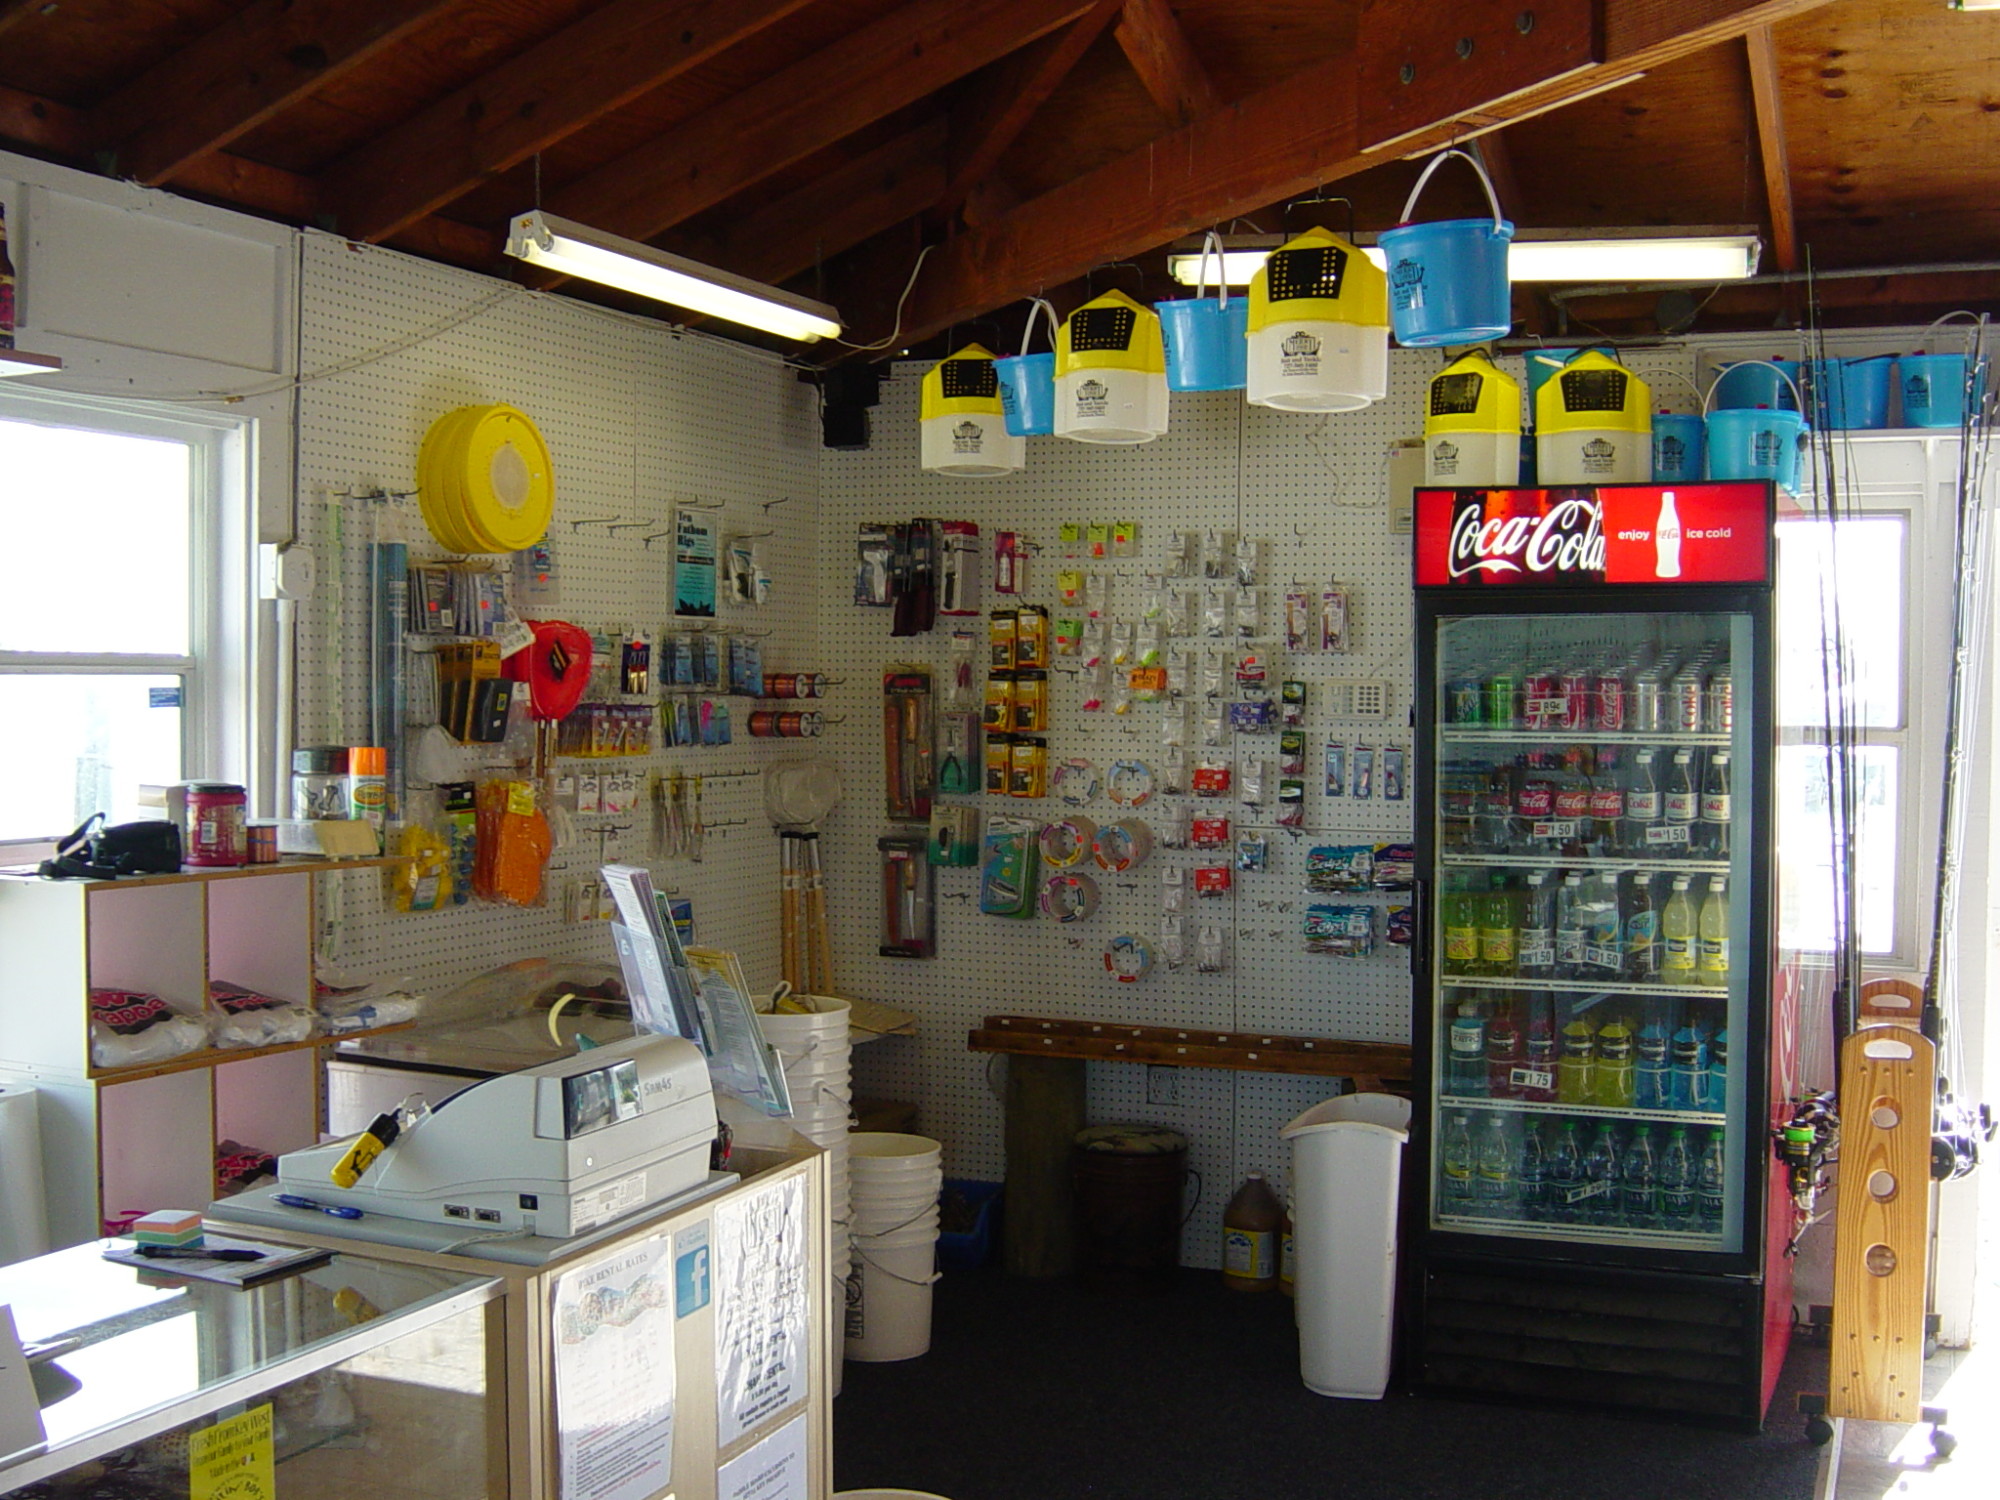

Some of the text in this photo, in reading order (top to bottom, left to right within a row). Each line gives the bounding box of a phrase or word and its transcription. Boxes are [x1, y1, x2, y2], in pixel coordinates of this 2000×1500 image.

[678, 511, 693, 522] Ten
[677, 522, 708, 536] Fathom
[1617, 529, 1650, 541] enjoy
[1686, 527, 1731, 539] ice cold
[677, 534, 695, 548] Rigs
[1449, 499, 1606, 577] Coca-Cola
